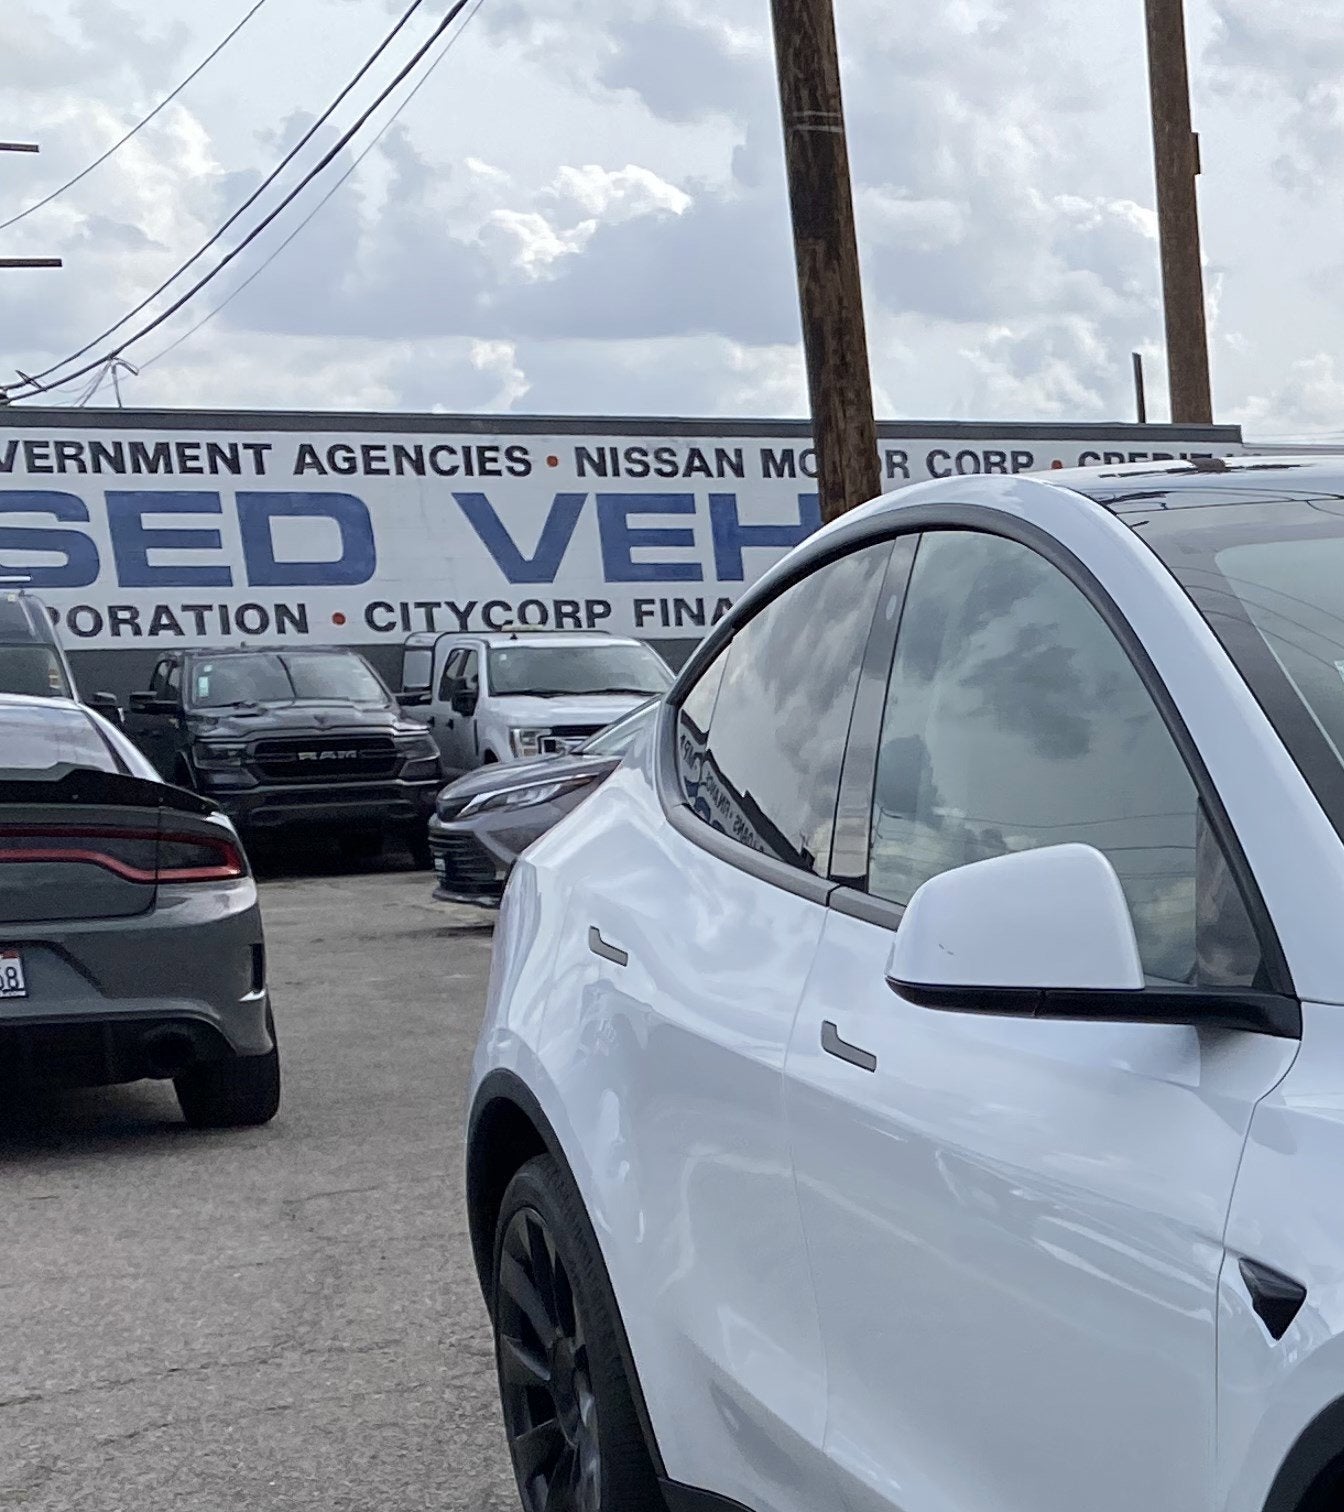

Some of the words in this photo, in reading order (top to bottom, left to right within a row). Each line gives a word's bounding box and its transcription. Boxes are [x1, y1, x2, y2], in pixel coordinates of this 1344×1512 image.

[293, 444, 532, 478] AGENCIES
[576, 446, 746, 478] NISSAN
[760, 448, 911, 479] MOR
[926, 449, 1034, 478] CORP
[46, 603, 309, 639] ORATION
[364, 599, 612, 632] CITYCORP
[0, 966, 19, 990] 8
